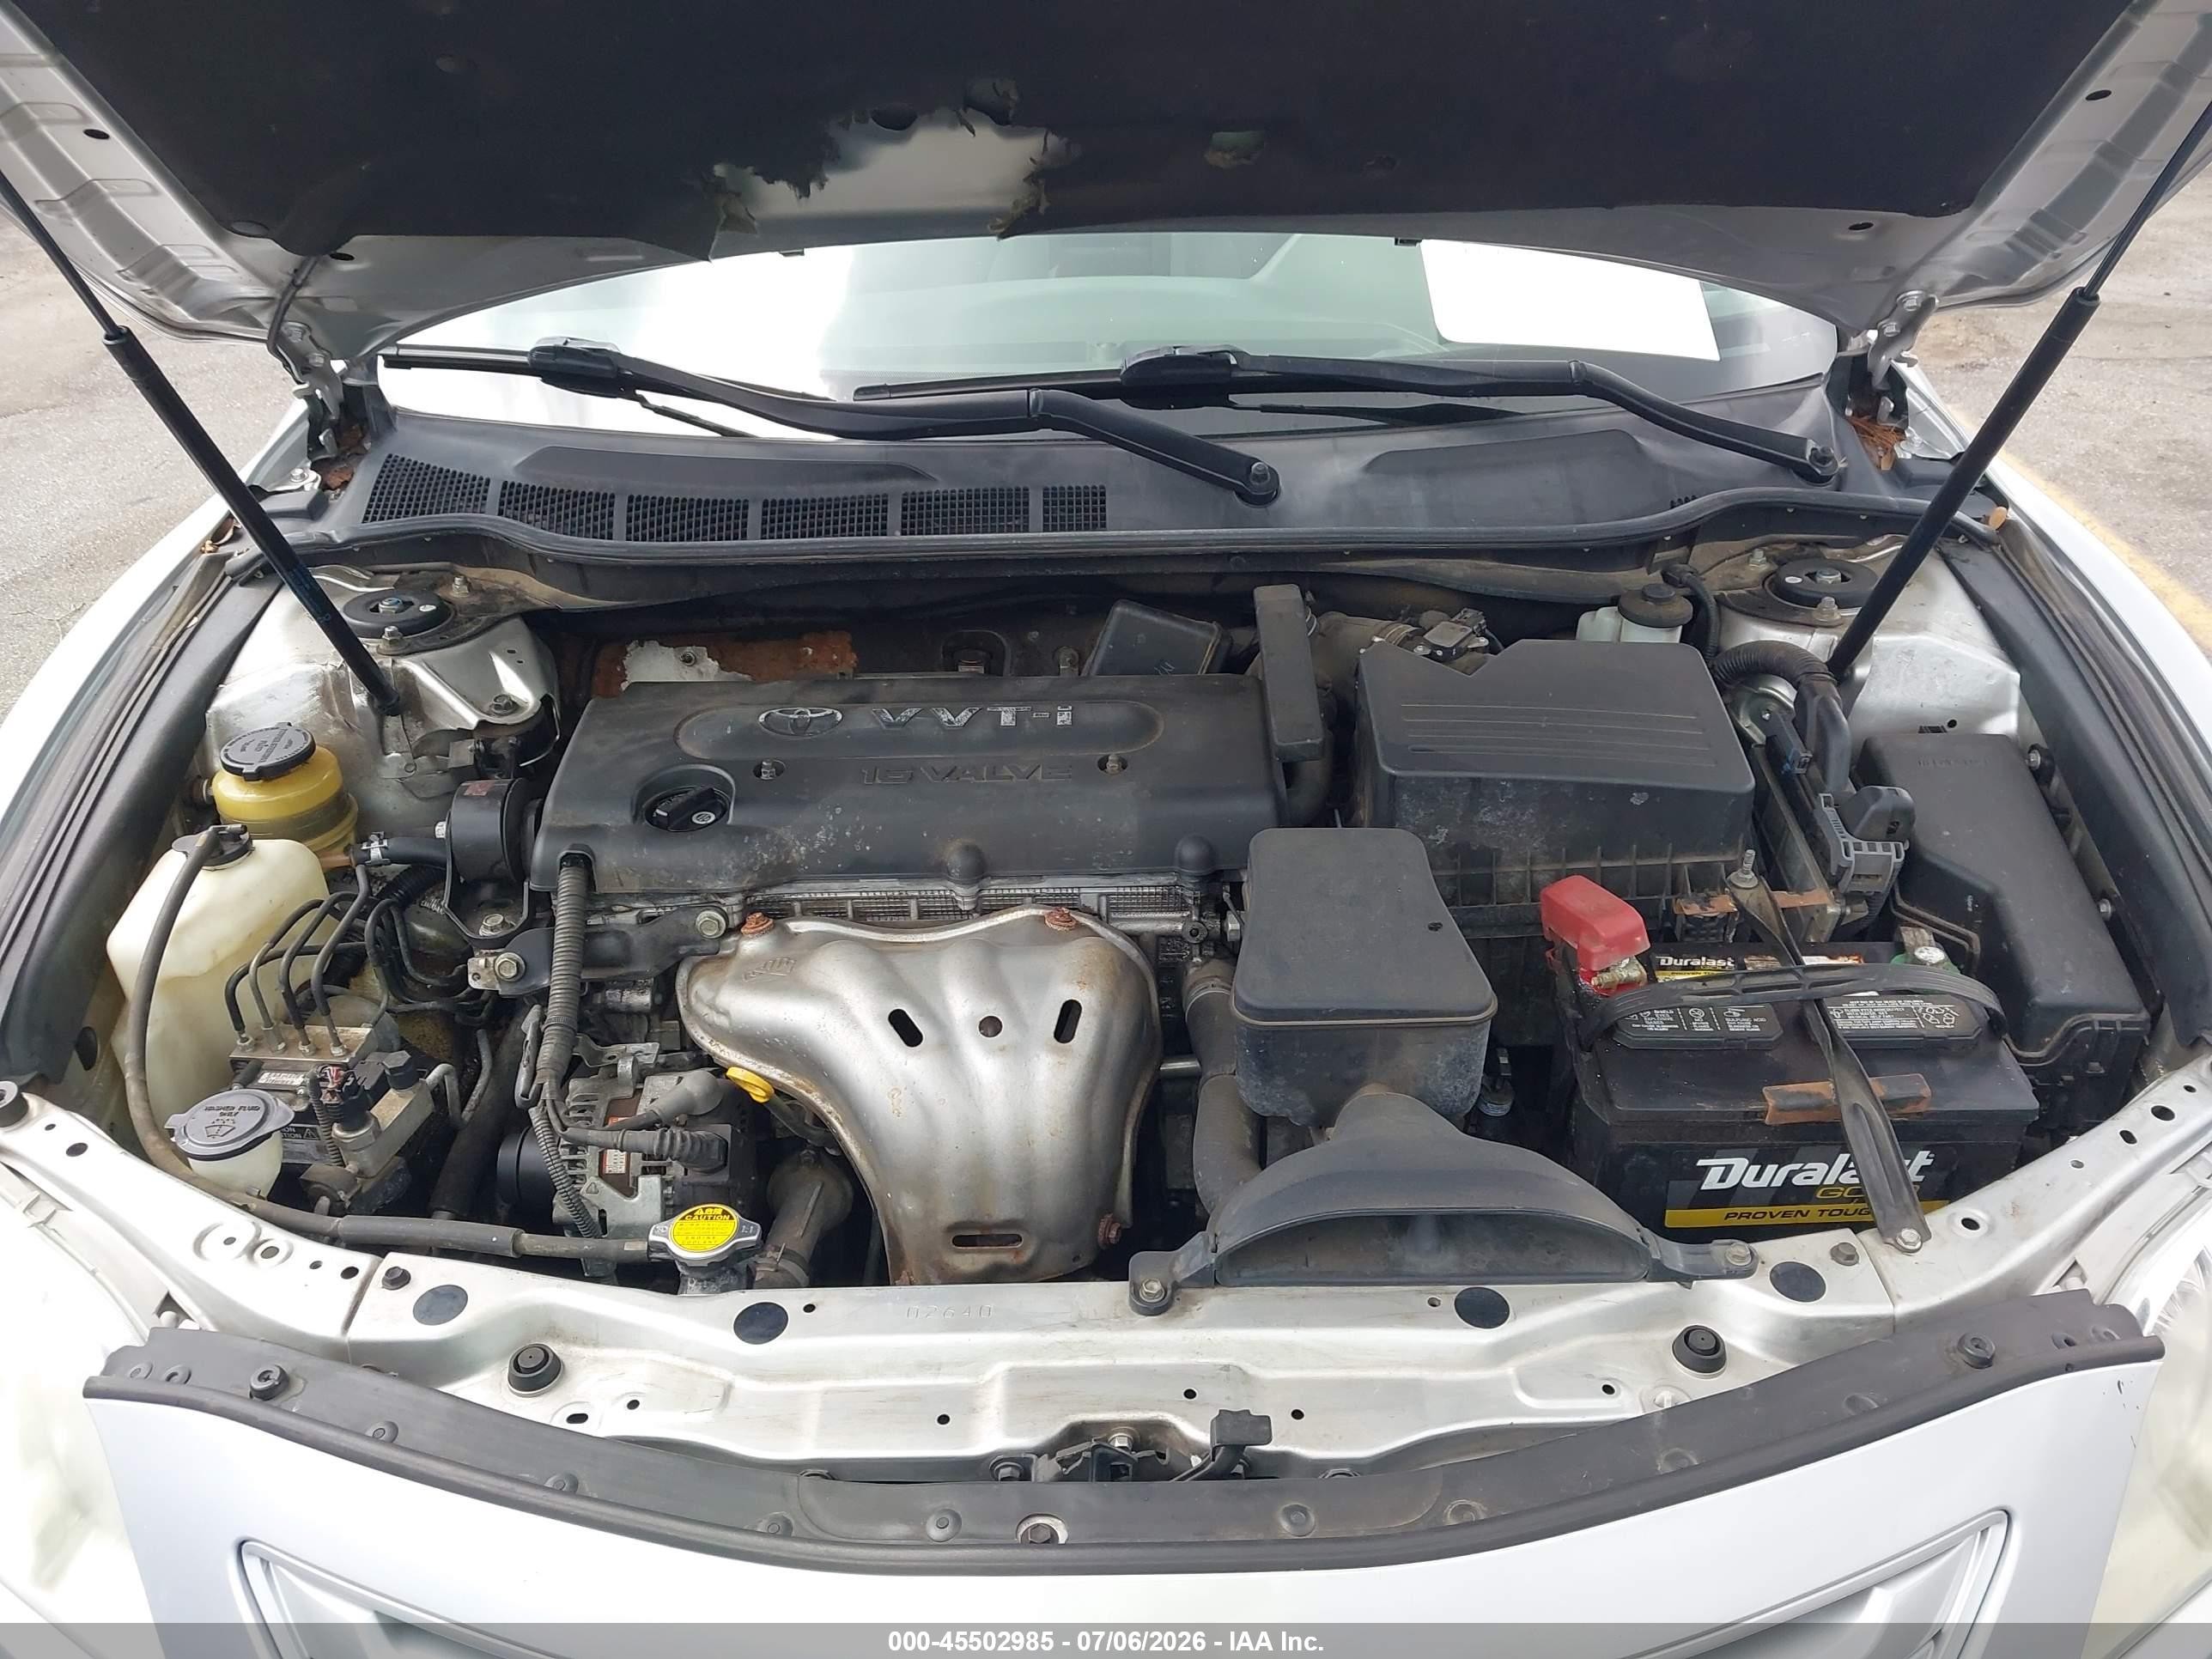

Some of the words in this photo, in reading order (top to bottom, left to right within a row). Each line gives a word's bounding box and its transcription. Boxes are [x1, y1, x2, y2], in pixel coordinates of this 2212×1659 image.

[872, 705, 1073, 730] VVT-i
[1655, 956, 1735, 967] Duralast
[1696, 1151, 1933, 1190] Duralat
[1723, 1209, 1810, 1221] PROVEN
[1817, 1207, 1871, 1218] TOUG
